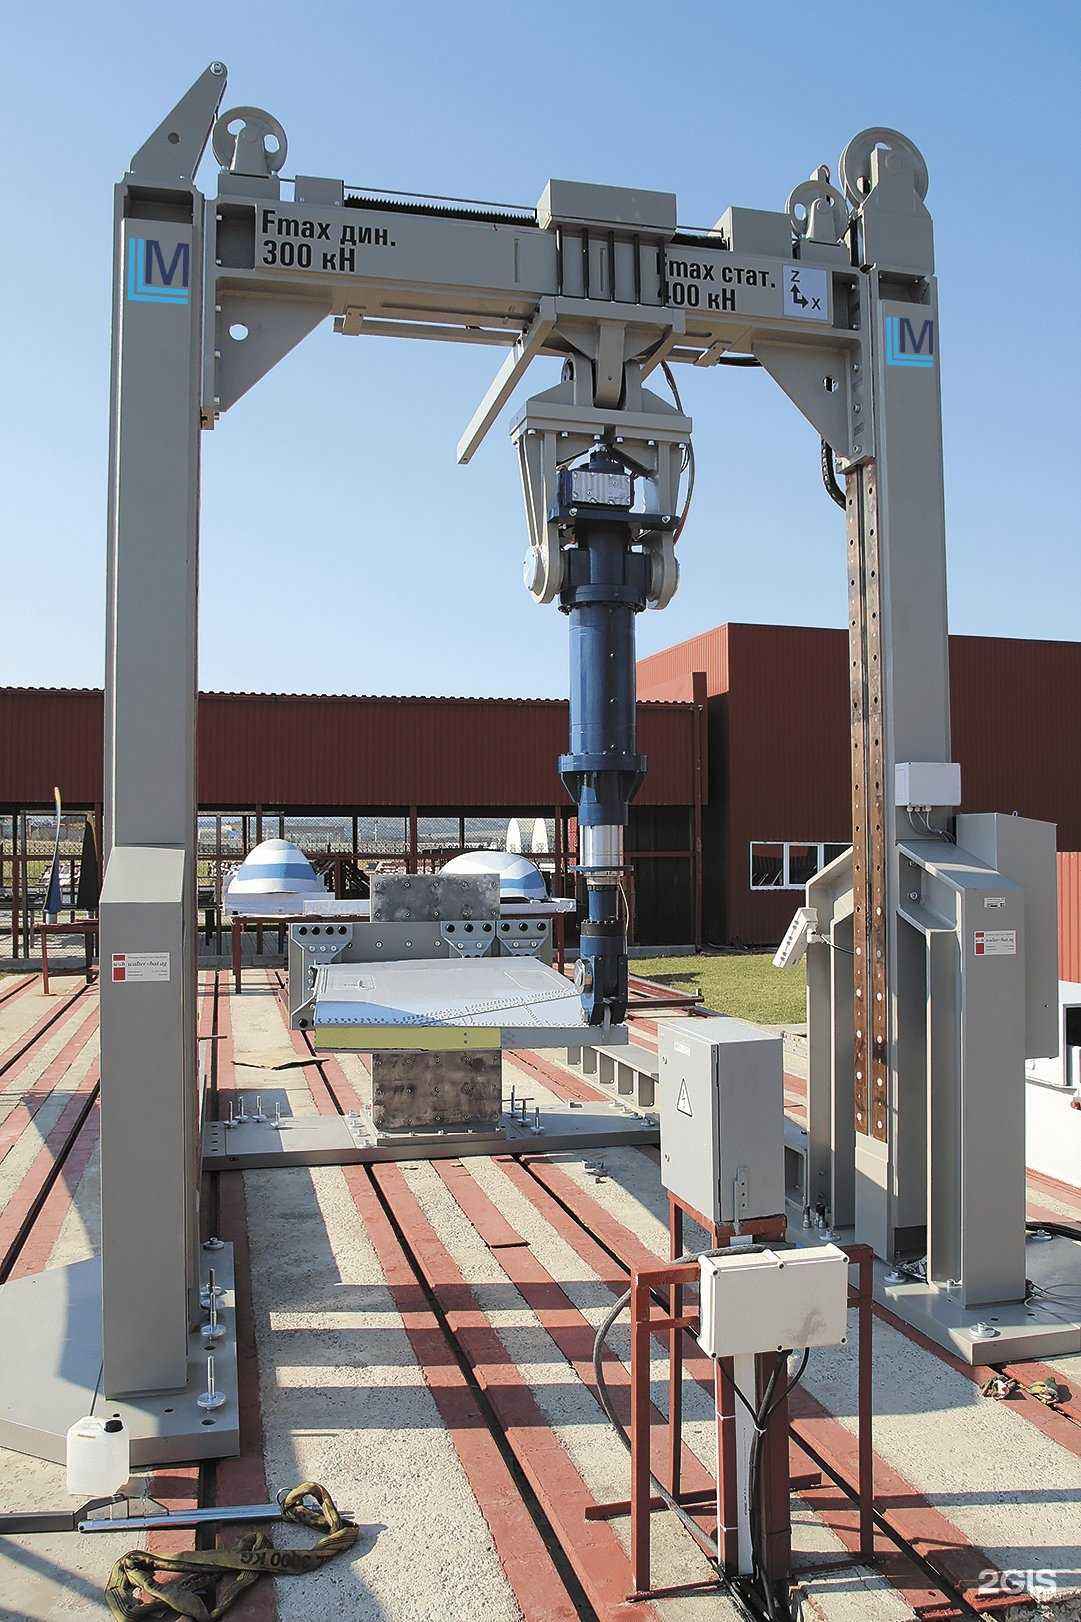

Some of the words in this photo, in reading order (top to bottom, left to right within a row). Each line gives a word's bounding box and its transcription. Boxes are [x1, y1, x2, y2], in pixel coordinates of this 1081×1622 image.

[262, 209, 331, 241] Fmax
[340, 225, 397, 247] дин.
[262, 239, 312, 268] 300
[322, 247, 355, 272] кН
[721, 266, 776, 289] стат.
[790, 269, 801, 283] Z
[707, 287, 736, 311] кН
